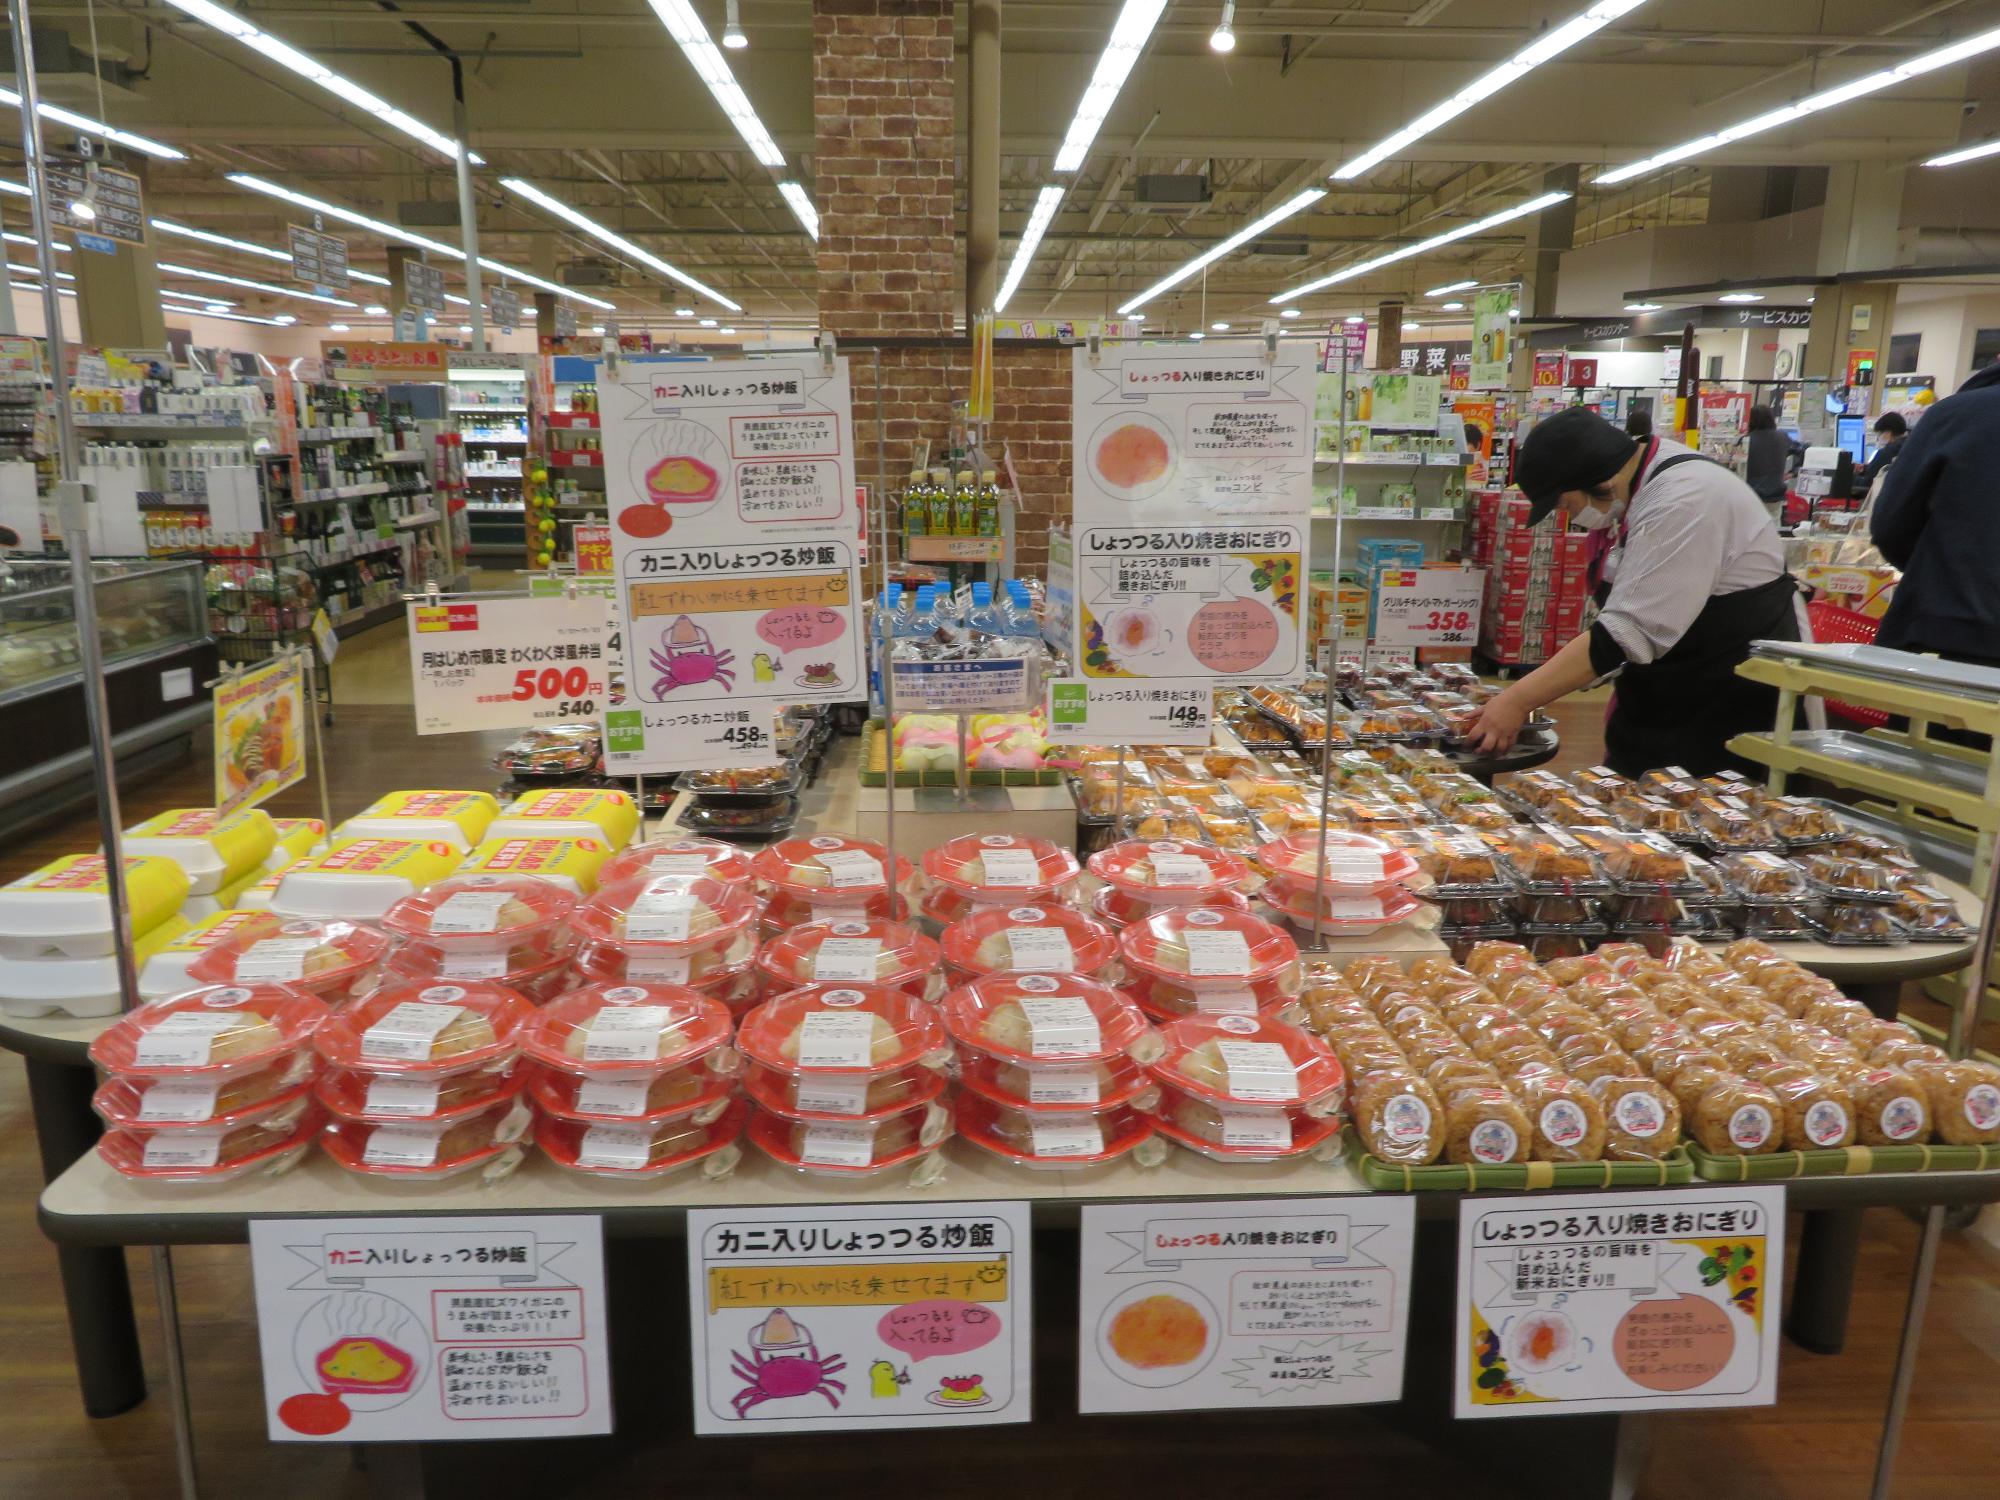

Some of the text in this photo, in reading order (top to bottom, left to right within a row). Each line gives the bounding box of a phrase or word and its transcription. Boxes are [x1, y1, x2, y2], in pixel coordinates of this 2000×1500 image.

[79, 135, 93, 158] 9
[1400, 347, 1447, 370] 野菜
[1129, 370, 1266, 383] しょっつる入り焼きおにぎり
[1581, 365, 1592, 380] 3
[654, 380, 798, 399] カニ入りしょっつる炒飯
[741, 431, 830, 441] うまみが詰まっています
[1089, 531, 1292, 551] しょっつる入り焼きおにぎり
[640, 546, 836, 573] カニ入りしょっつる炒飯
[1119, 557, 1211, 569] しょっつるの旨味を
[1118, 570, 1173, 582] 詰め込んだ
[765, 626, 813, 640] 入ってるよ
[422, 643, 601, 669] 月はじめ市限定 わくわく洋風弁当
[1088, 689, 1207, 702] しょっつる入り焼きおにぎり
[644, 710, 750, 728] しょっつるカニ炒飯
[1482, 1209, 1758, 1242] しょっつる入り焼きおにぎり
[717, 1222, 994, 1253] カニ入りしょっつる炒飯
[1155, 1229, 1337, 1249] しょっつる入り焼きおにぎり
[328, 1245, 527, 1265] カニ入りしょっつる炒飯
[1518, 1243, 1652, 1262] しょっつるの旨味を
[1516, 1260, 1592, 1277] 詰め込んだ
[448, 1309, 571, 1321] うまみが詰まっています
[889, 1326, 954, 1345] 入ってるよ
